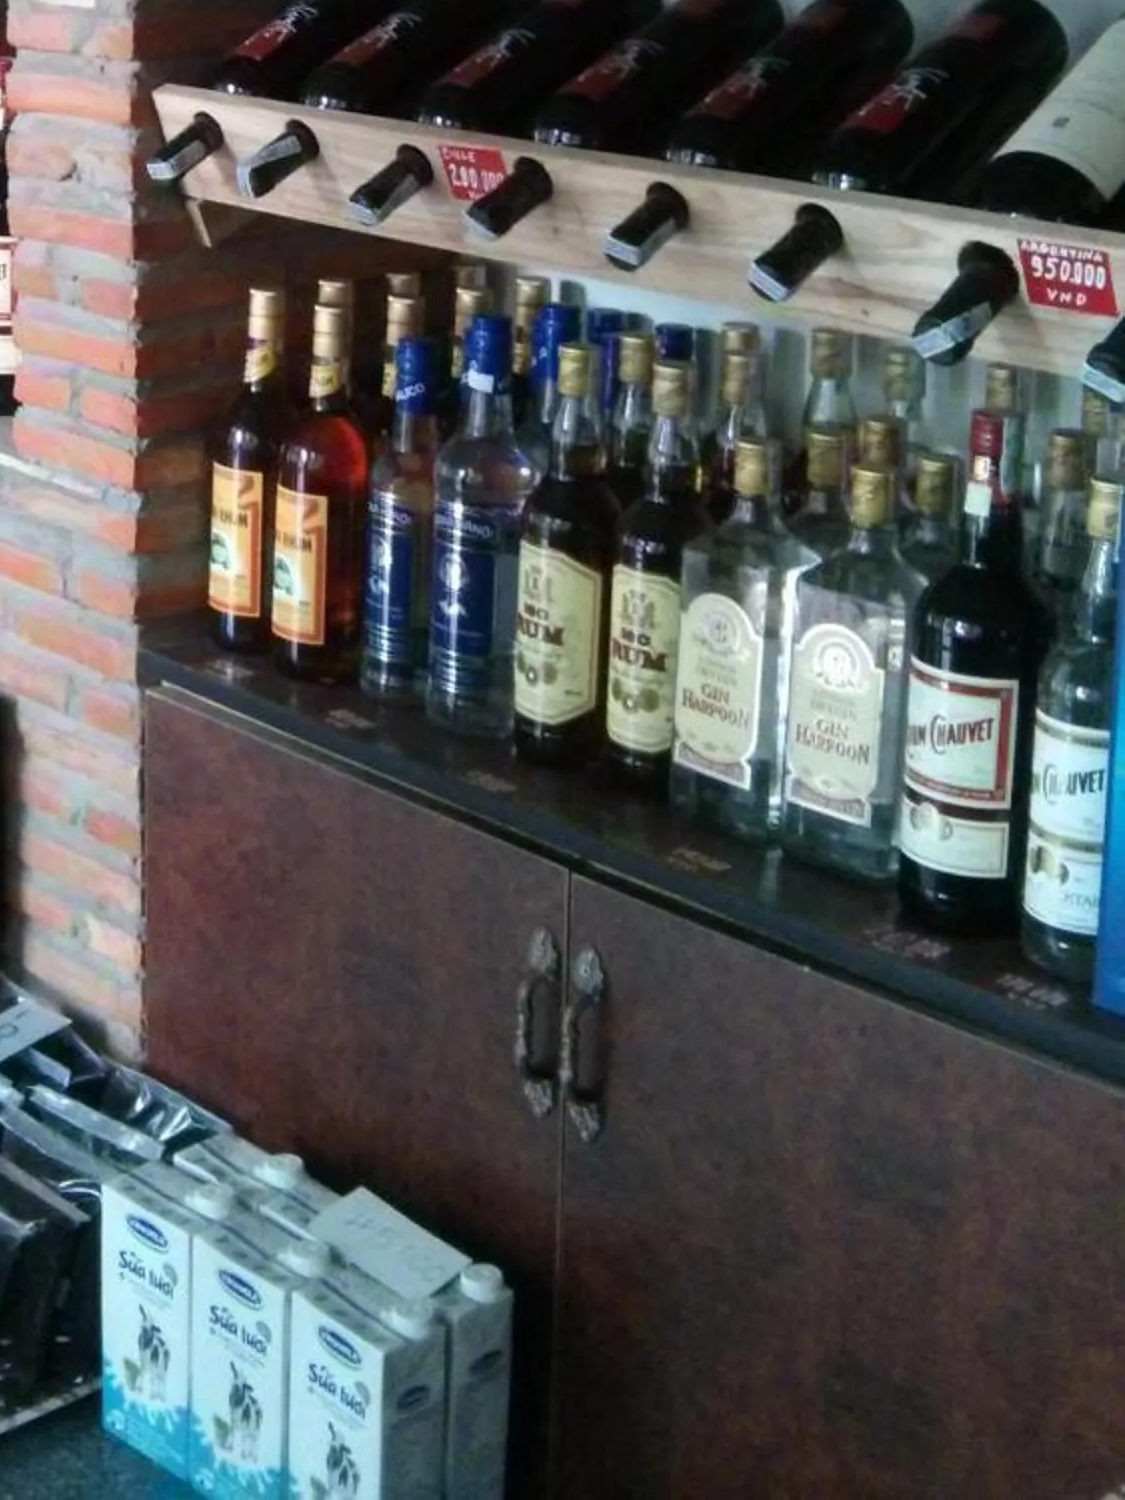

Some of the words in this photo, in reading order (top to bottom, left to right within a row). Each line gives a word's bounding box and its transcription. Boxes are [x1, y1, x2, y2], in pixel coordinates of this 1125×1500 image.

[1020, 241, 1104, 262] ARGENTINA
[1030, 254, 1106, 290] 950.000
[1045, 287, 1087, 306] VND
[612, 636, 668, 672] RUM
[700, 683, 730, 705] GIN
[816, 718, 849, 739] GIN
[930, 714, 995, 756] CHAUVET
